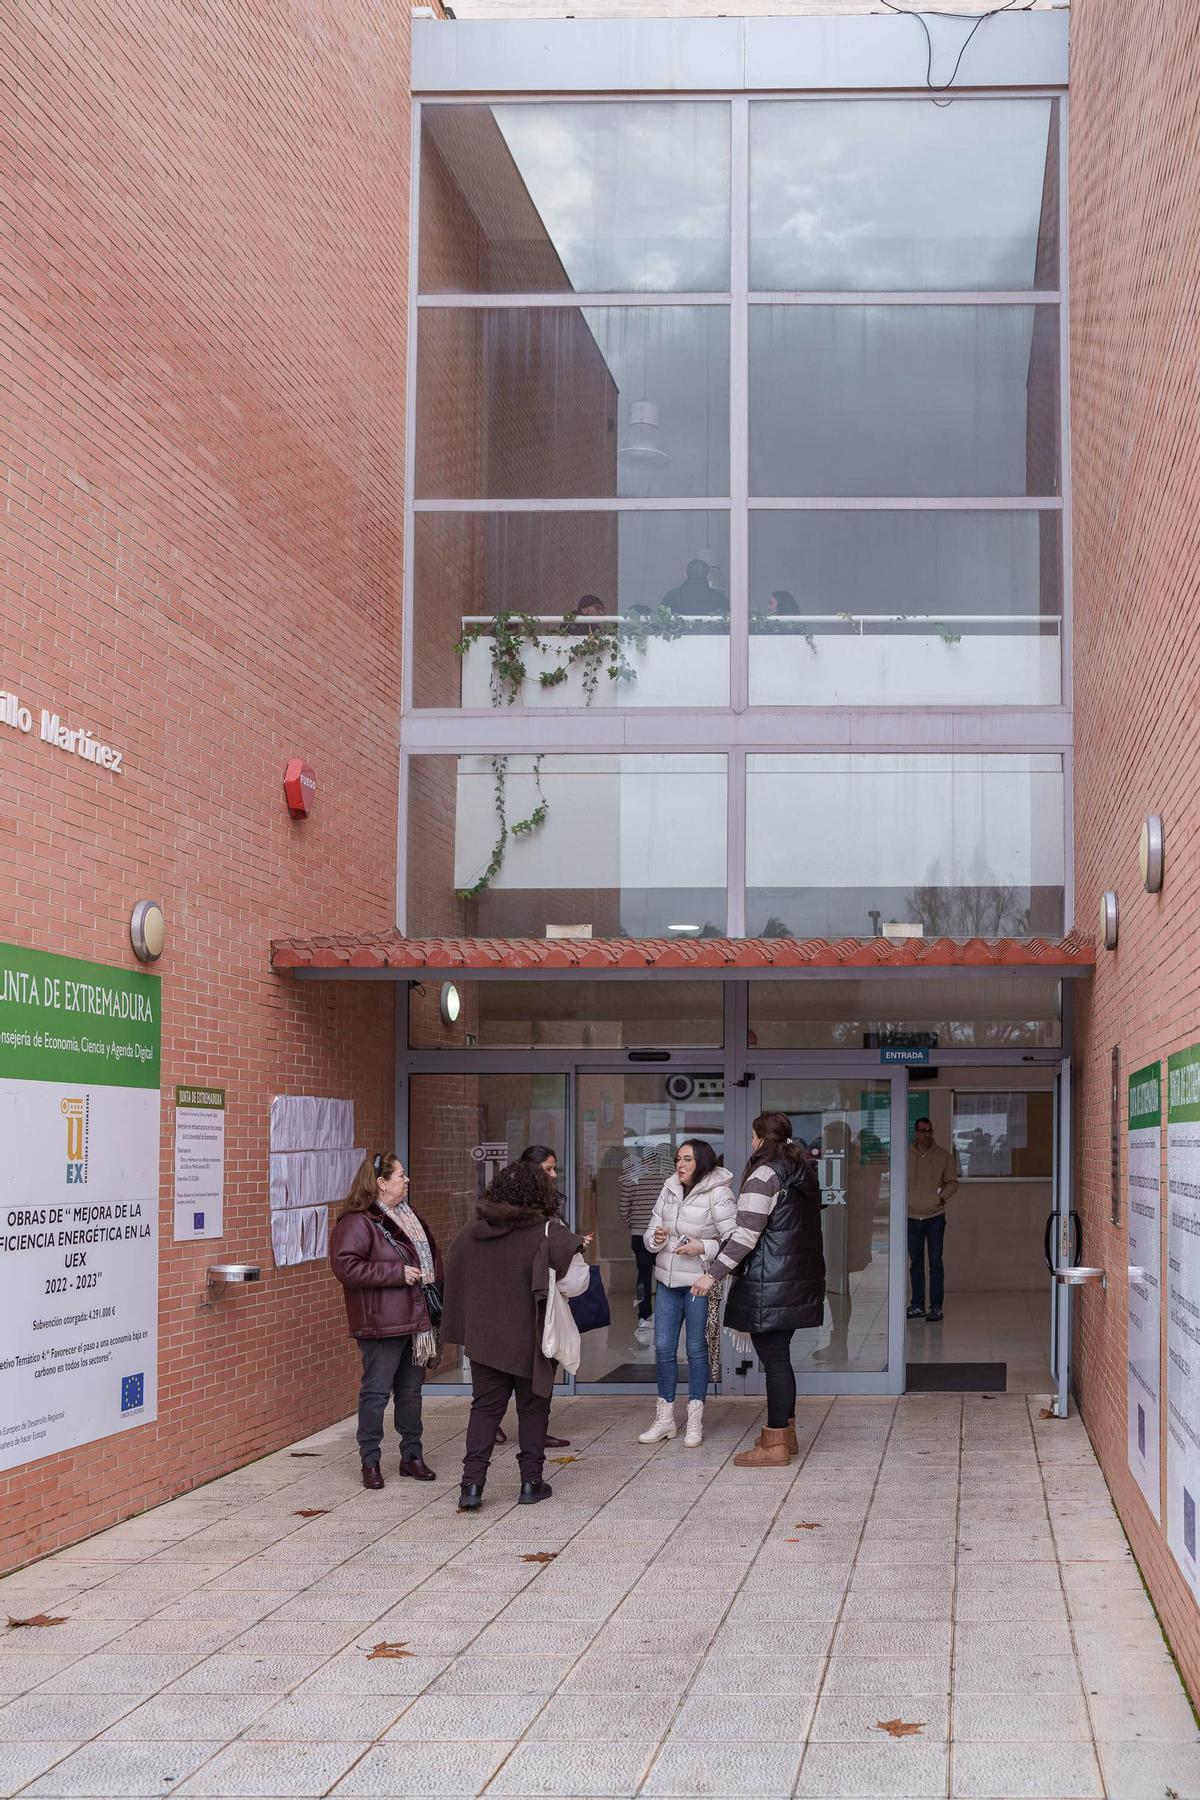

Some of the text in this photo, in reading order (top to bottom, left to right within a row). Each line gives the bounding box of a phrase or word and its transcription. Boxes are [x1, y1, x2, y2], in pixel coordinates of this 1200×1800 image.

[40, 708, 123, 774] Martínez
[300, 774, 317, 790] FUEGO
[44, 977, 60, 1009] DE
[64, 981, 153, 1023] EXTREMADURA
[33, 1031, 43, 1047] de
[44, 1032, 80, 1053] Economía,
[81, 1036, 105, 1055] Ciencia
[106, 1045, 111, 1059] y
[111, 1041, 133, 1060] Agenda
[135, 1044, 153, 1063] Digital
[886, 1051, 924, 1059] ENTRADA
[66, 1163, 84, 1184] EX
[821, 1190, 847, 1205] EX
[7, 1209, 46, 1227] OBRAS
[49, 1208, 63, 1224] DE
[73, 1205, 112, 1224] MEJORA
[115, 1205, 127, 1219] DE
[130, 1204, 142, 1217] LA
[58, 1224, 122, 1246] ENERGÉTICA
[125, 1225, 138, 1239] EN
[140, 1223, 151, 1238] LA
[64, 1252, 87, 1268] UEX
[45, 1277, 67, 1295] 2022
[32, 1306, 116, 1331] Subvención otorgada: 4.291.000 €
[15, 1352, 41, 1367] Temático
[50, 1345, 77, 1359] Favorecer
[77, 1341, 83, 1351] el
[83, 1340, 95, 1354] paso
[100, 1338, 109, 1348] una
[109, 1332, 132, 1346] economía
[132, 1330, 142, 1342] baja
[142, 1330, 148, 1338] en
[34, 1364, 57, 1379] carbono
[57, 1364, 65, 1373] en
[65, 1359, 80, 1371] todos
[80, 1356, 89, 1368] los
